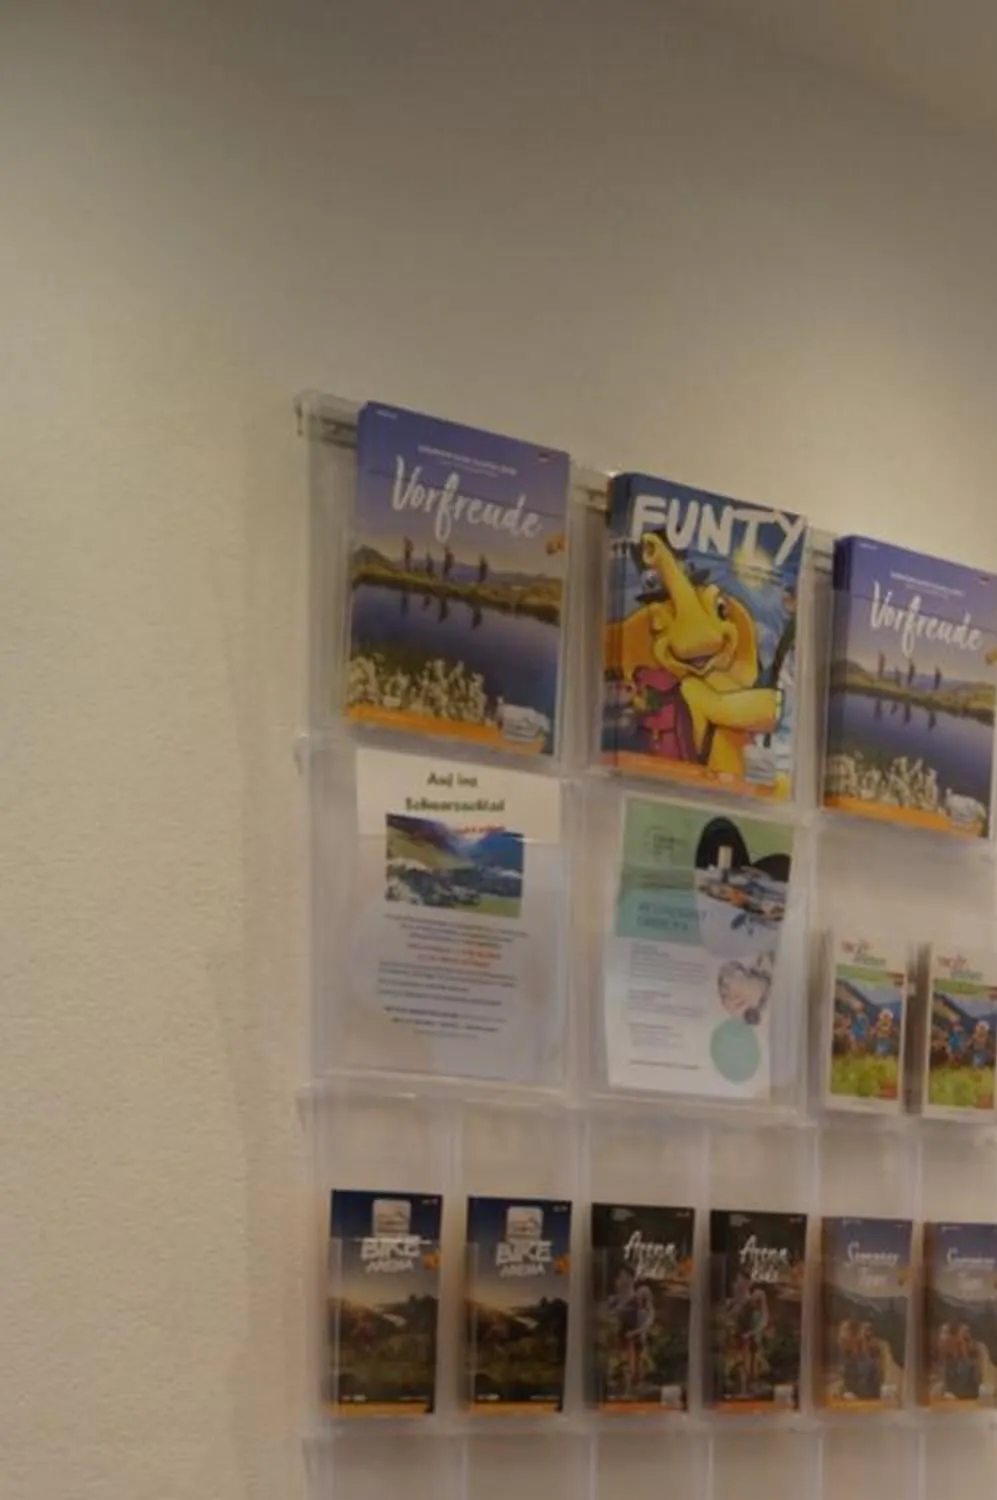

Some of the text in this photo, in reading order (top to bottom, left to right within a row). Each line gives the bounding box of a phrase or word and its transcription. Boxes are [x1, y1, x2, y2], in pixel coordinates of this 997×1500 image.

[391, 454, 542, 544] Vorfreude
[630, 493, 806, 567] FUNTY
[869, 580, 983, 658] Vorfreude
[361, 1236, 421, 1260] BIKE
[495, 1240, 552, 1265] BIKE
[623, 1230, 677, 1262] Arena
[739, 1234, 789, 1264] Arena
